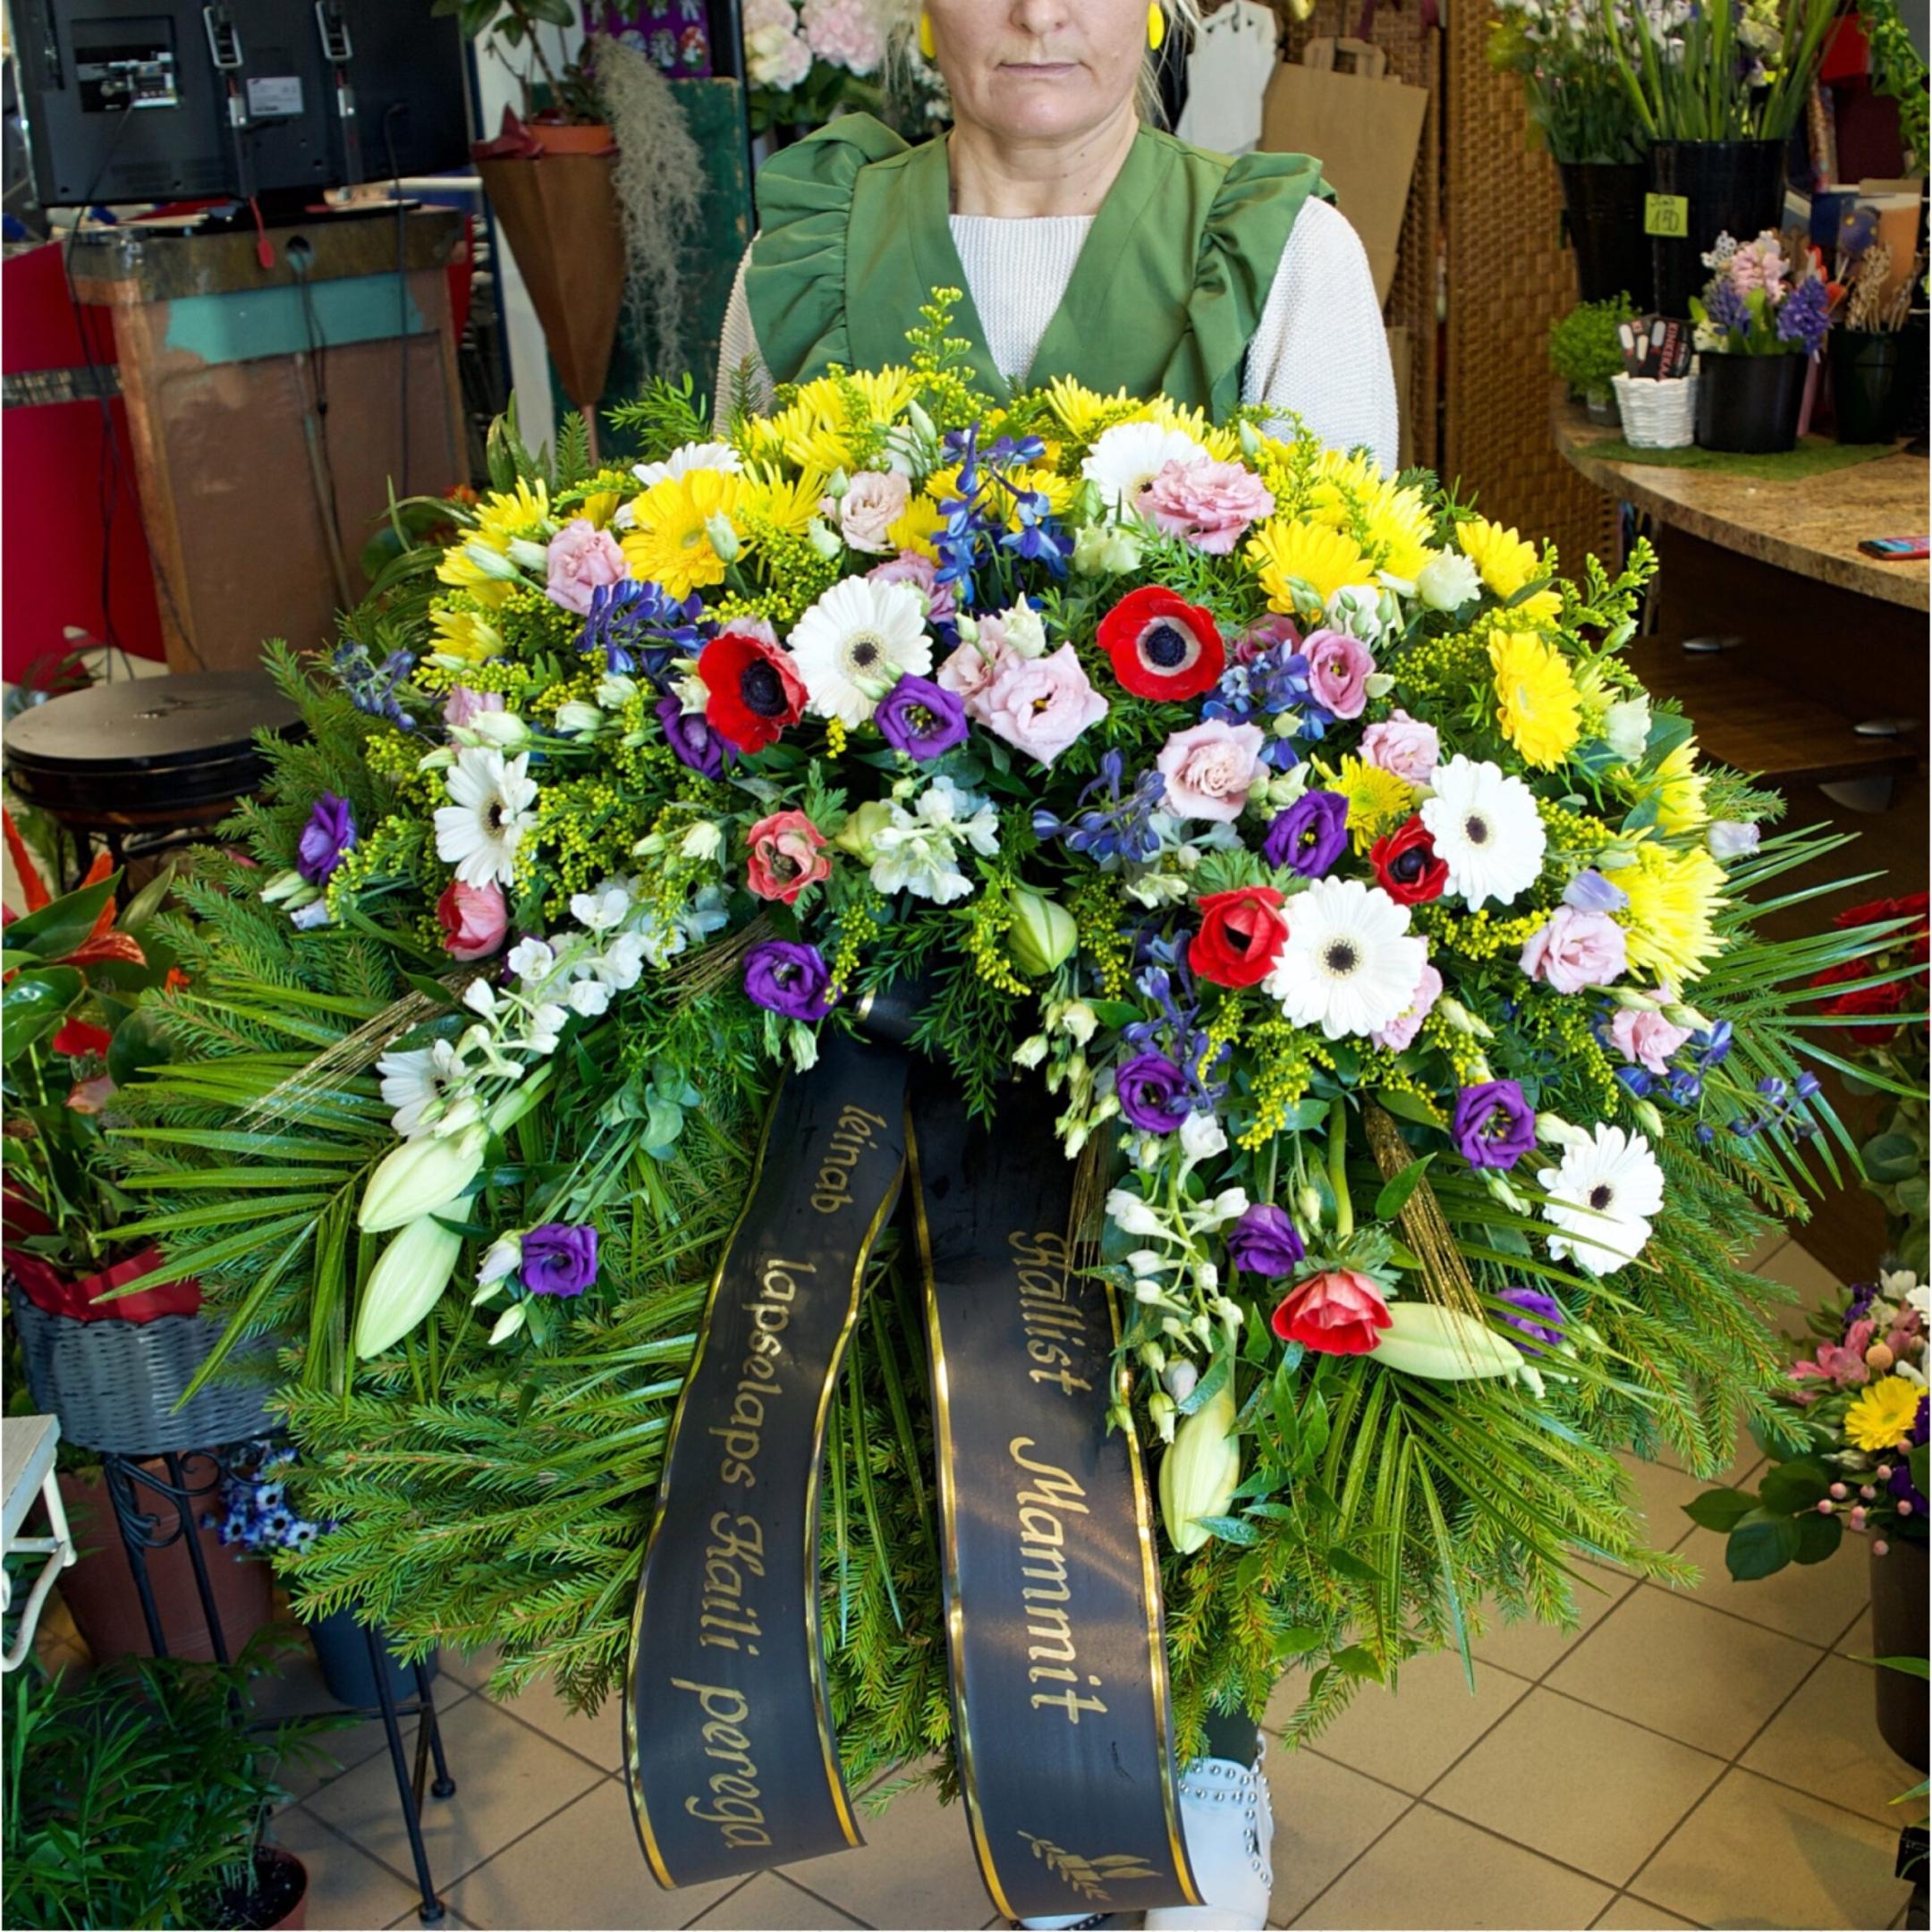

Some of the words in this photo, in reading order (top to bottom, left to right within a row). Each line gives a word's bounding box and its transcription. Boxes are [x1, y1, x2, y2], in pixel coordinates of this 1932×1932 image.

[809, 1104, 888, 1215] leinab
[708, 1258, 818, 1489] lapselaps
[1007, 1230, 1093, 1396] Kallist
[698, 1510, 766, 1657] Kaili
[1008, 1436, 1109, 1724] Mammit
[670, 1675, 773, 1850] perega
